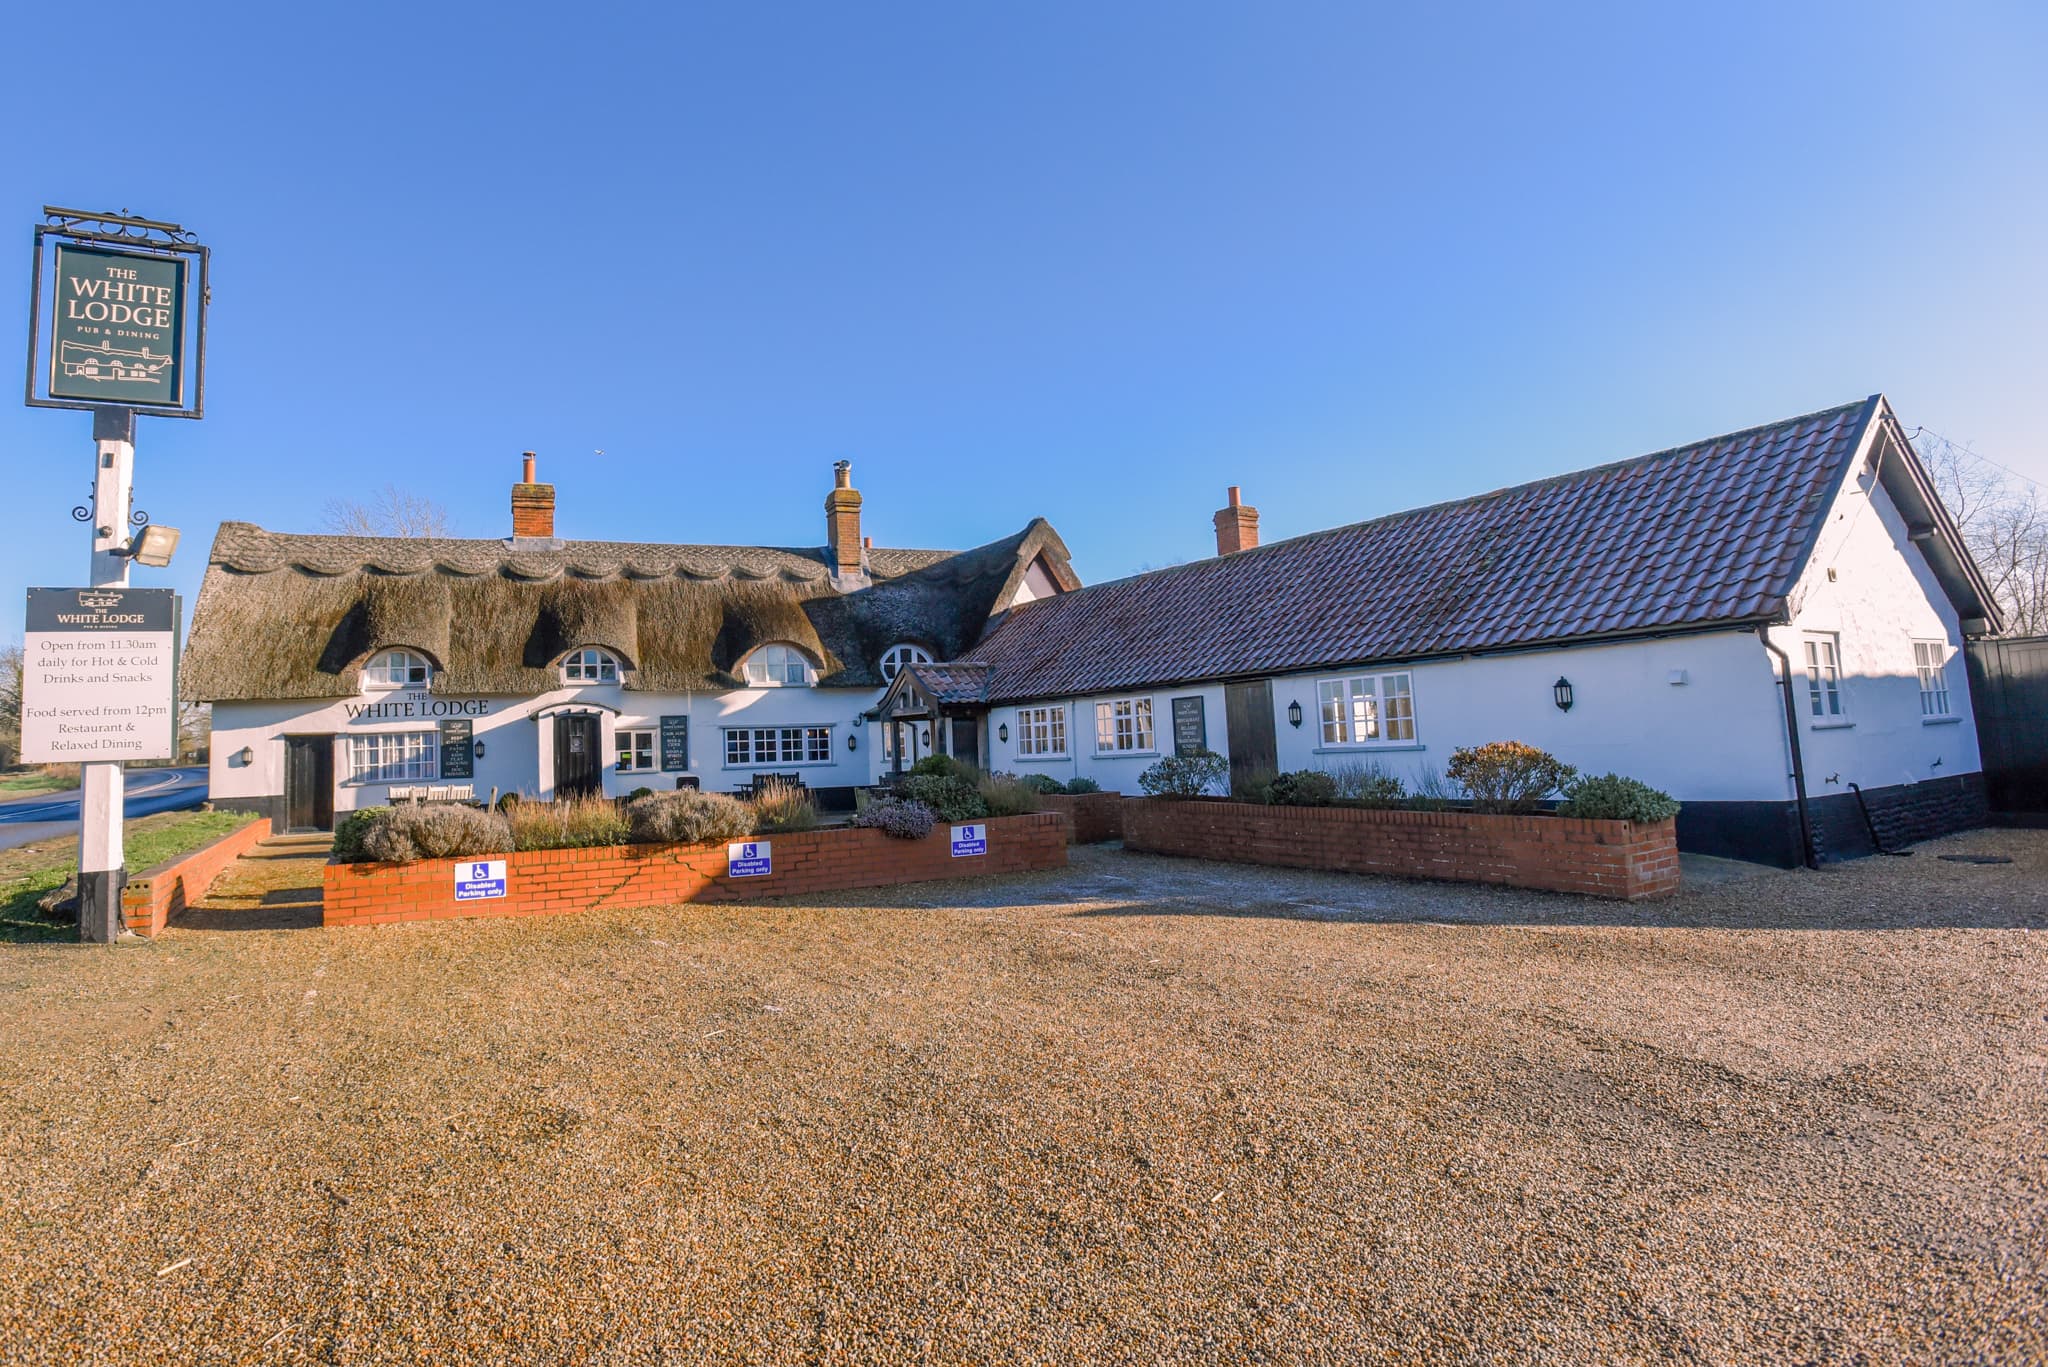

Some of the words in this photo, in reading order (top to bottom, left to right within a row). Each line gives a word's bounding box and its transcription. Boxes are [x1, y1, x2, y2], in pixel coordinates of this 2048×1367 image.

[107, 267, 137, 280] THE
[70, 277, 171, 306] WHITE
[68, 300, 170, 328] LODGE
[77, 326, 99, 334] PUB
[118, 330, 160, 340] DINING
[57, 614, 100, 624] WHITE
[102, 614, 144, 623] LODGE
[41, 640, 74, 653] Open
[78, 640, 106, 650] from
[111, 640, 156, 649] 11.30am
[38, 657, 67, 669] daily
[72, 657, 88, 666] for
[92, 657, 114, 666] Hot
[117, 657, 127, 666] &
[131, 656, 158, 666] Cold
[44, 674, 84, 684] Drinks
[87, 673, 108, 683] and
[113, 672, 152, 682] Snacks
[407, 692, 427, 700] THE
[27, 708, 56, 718] Food
[60, 707, 99, 717] served
[104, 706, 131, 716] from
[135, 705, 167, 717] 12pm
[344, 702, 414, 718] WHITE
[421, 700, 489, 716] LODGE
[59, 723, 122, 734] Restaurant
[125, 723, 135, 732] &
[51, 740, 98, 750] Relaxed
[102, 739, 142, 750] Dining
[465, 881, 496, 890] Disabled
